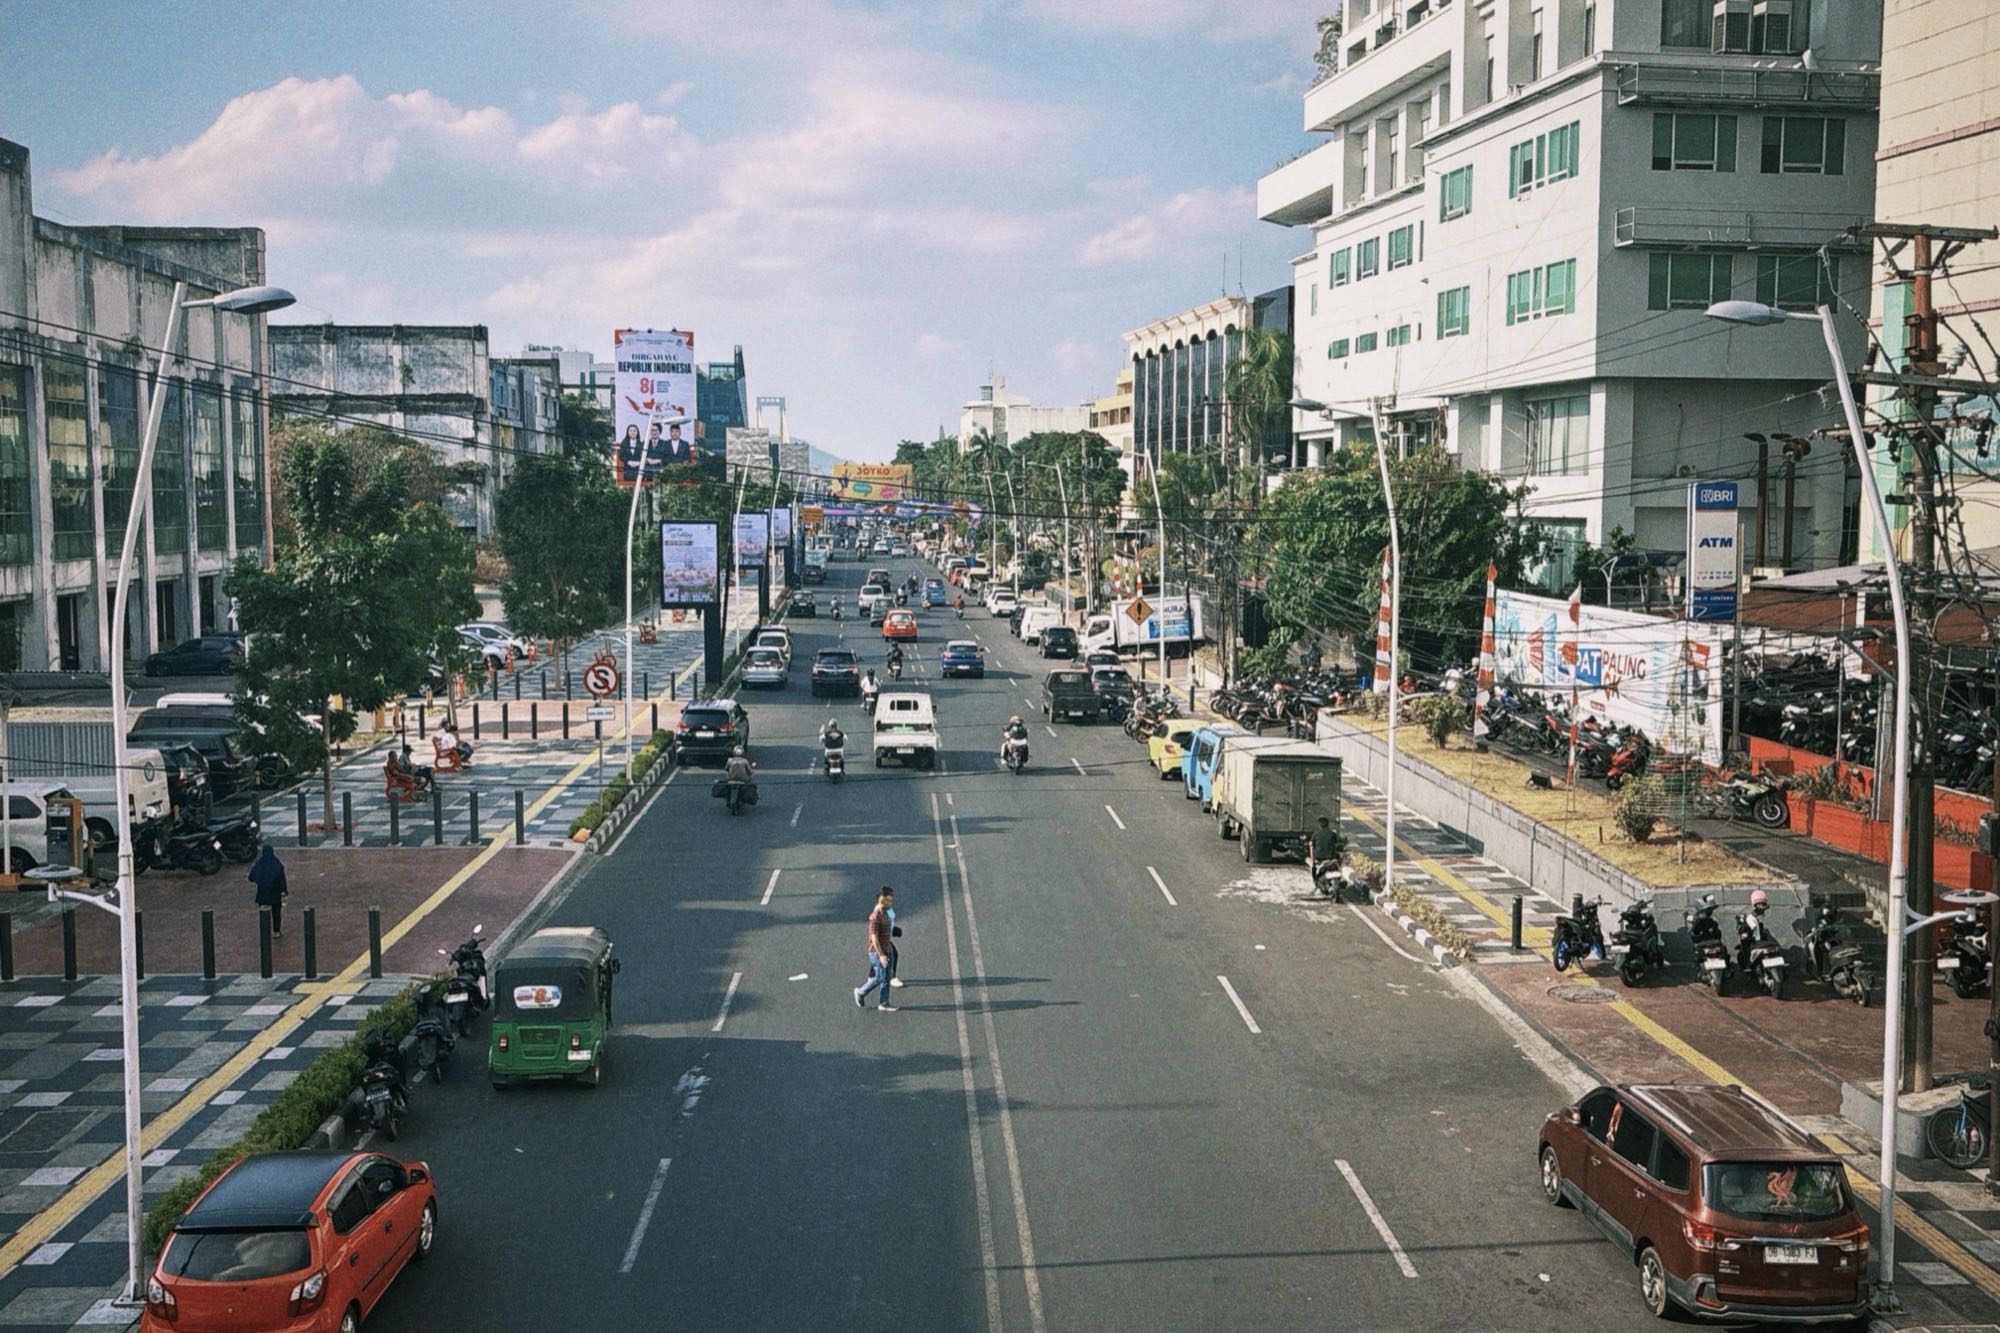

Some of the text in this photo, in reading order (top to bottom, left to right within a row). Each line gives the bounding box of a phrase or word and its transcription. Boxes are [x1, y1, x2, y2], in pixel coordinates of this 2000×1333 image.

[618, 361, 692, 374] REPUBLIK INDONESIA
[857, 467, 890, 476] JOYKO
[1699, 537, 1733, 548] ATM
[1602, 650, 1647, 680] PALING
